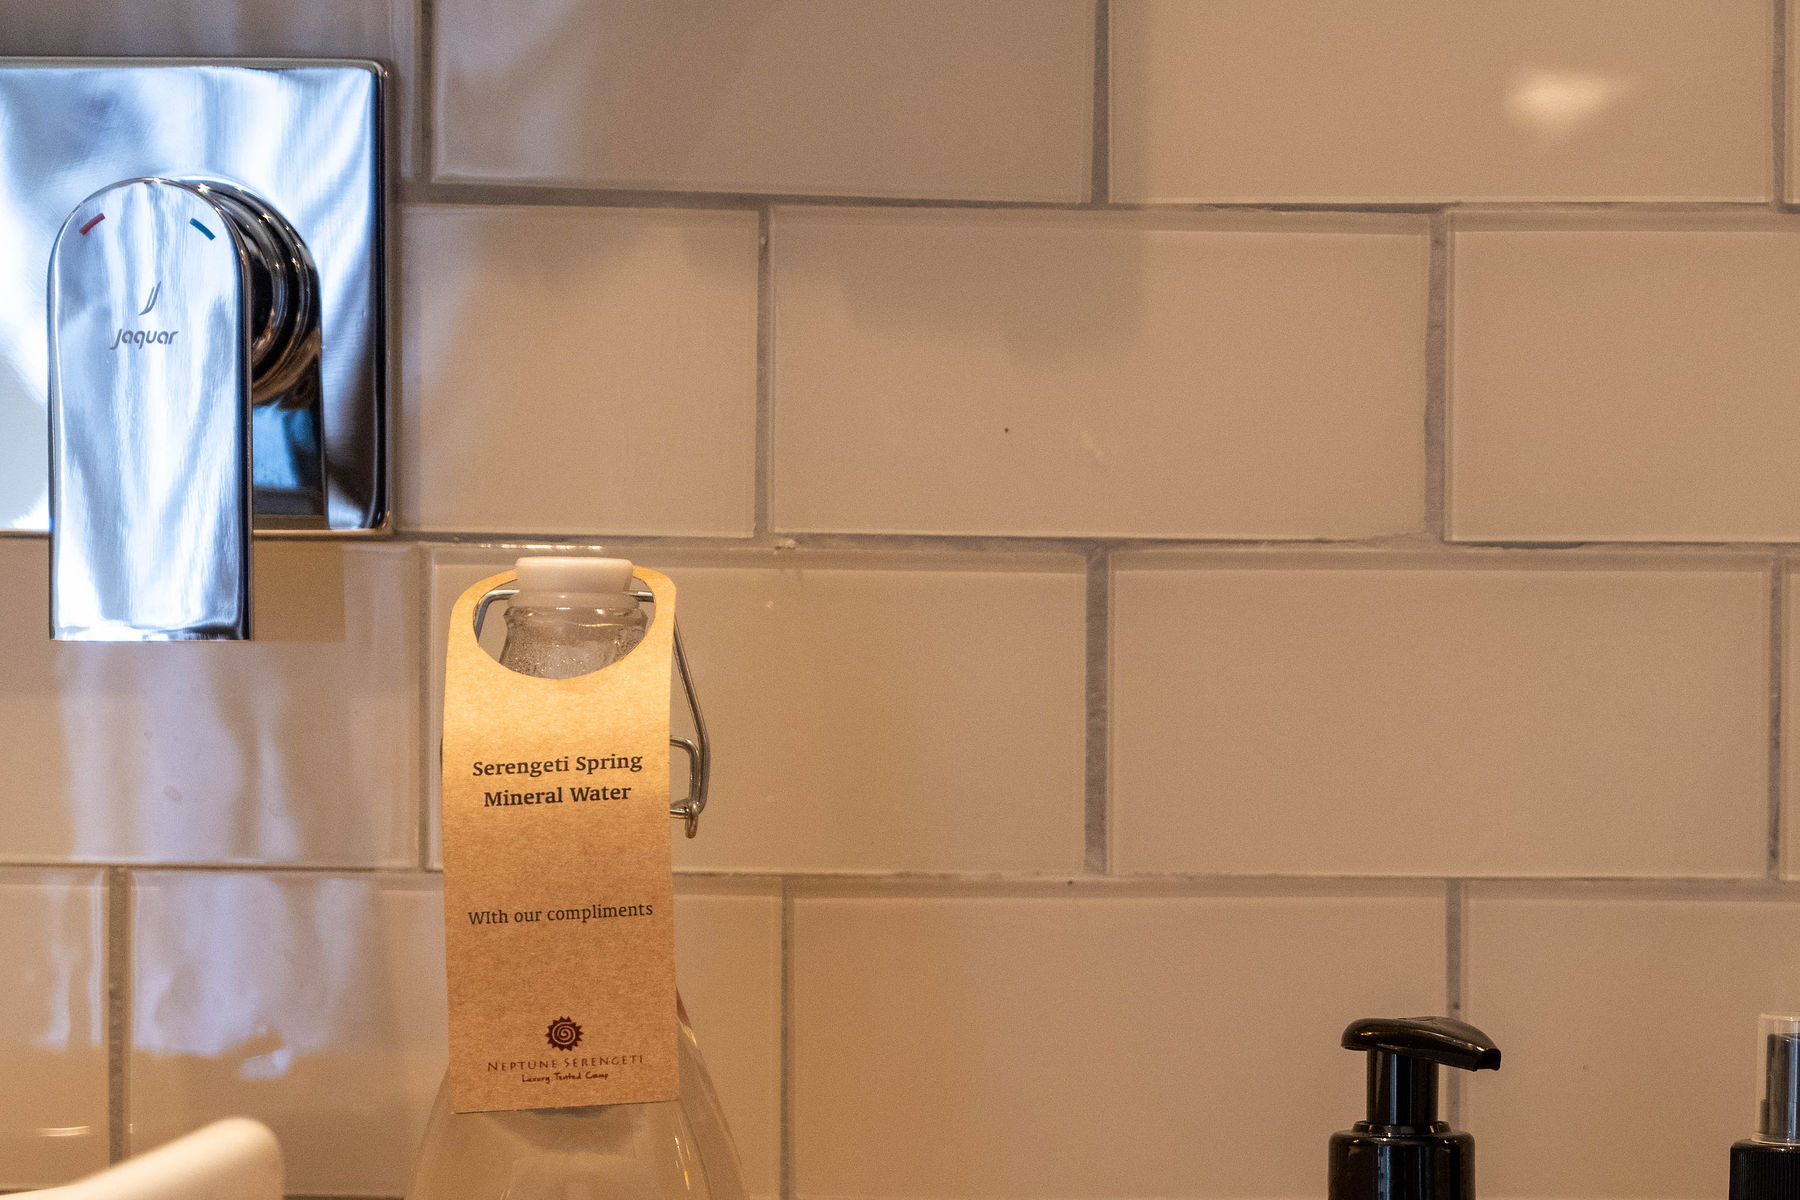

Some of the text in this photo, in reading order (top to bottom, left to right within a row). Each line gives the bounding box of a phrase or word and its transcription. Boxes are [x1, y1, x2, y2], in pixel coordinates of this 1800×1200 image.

[472, 753, 643, 777] Serengeti Spring
[484, 784, 631, 807] Mineral Water
[514, 910, 542, 923] our
[547, 904, 653, 923] compliments
[487, 1054, 643, 1072] NEPTUNE SERENGETI
[554, 1072, 581, 1081] Tented
[586, 1071, 608, 1080] Camp
